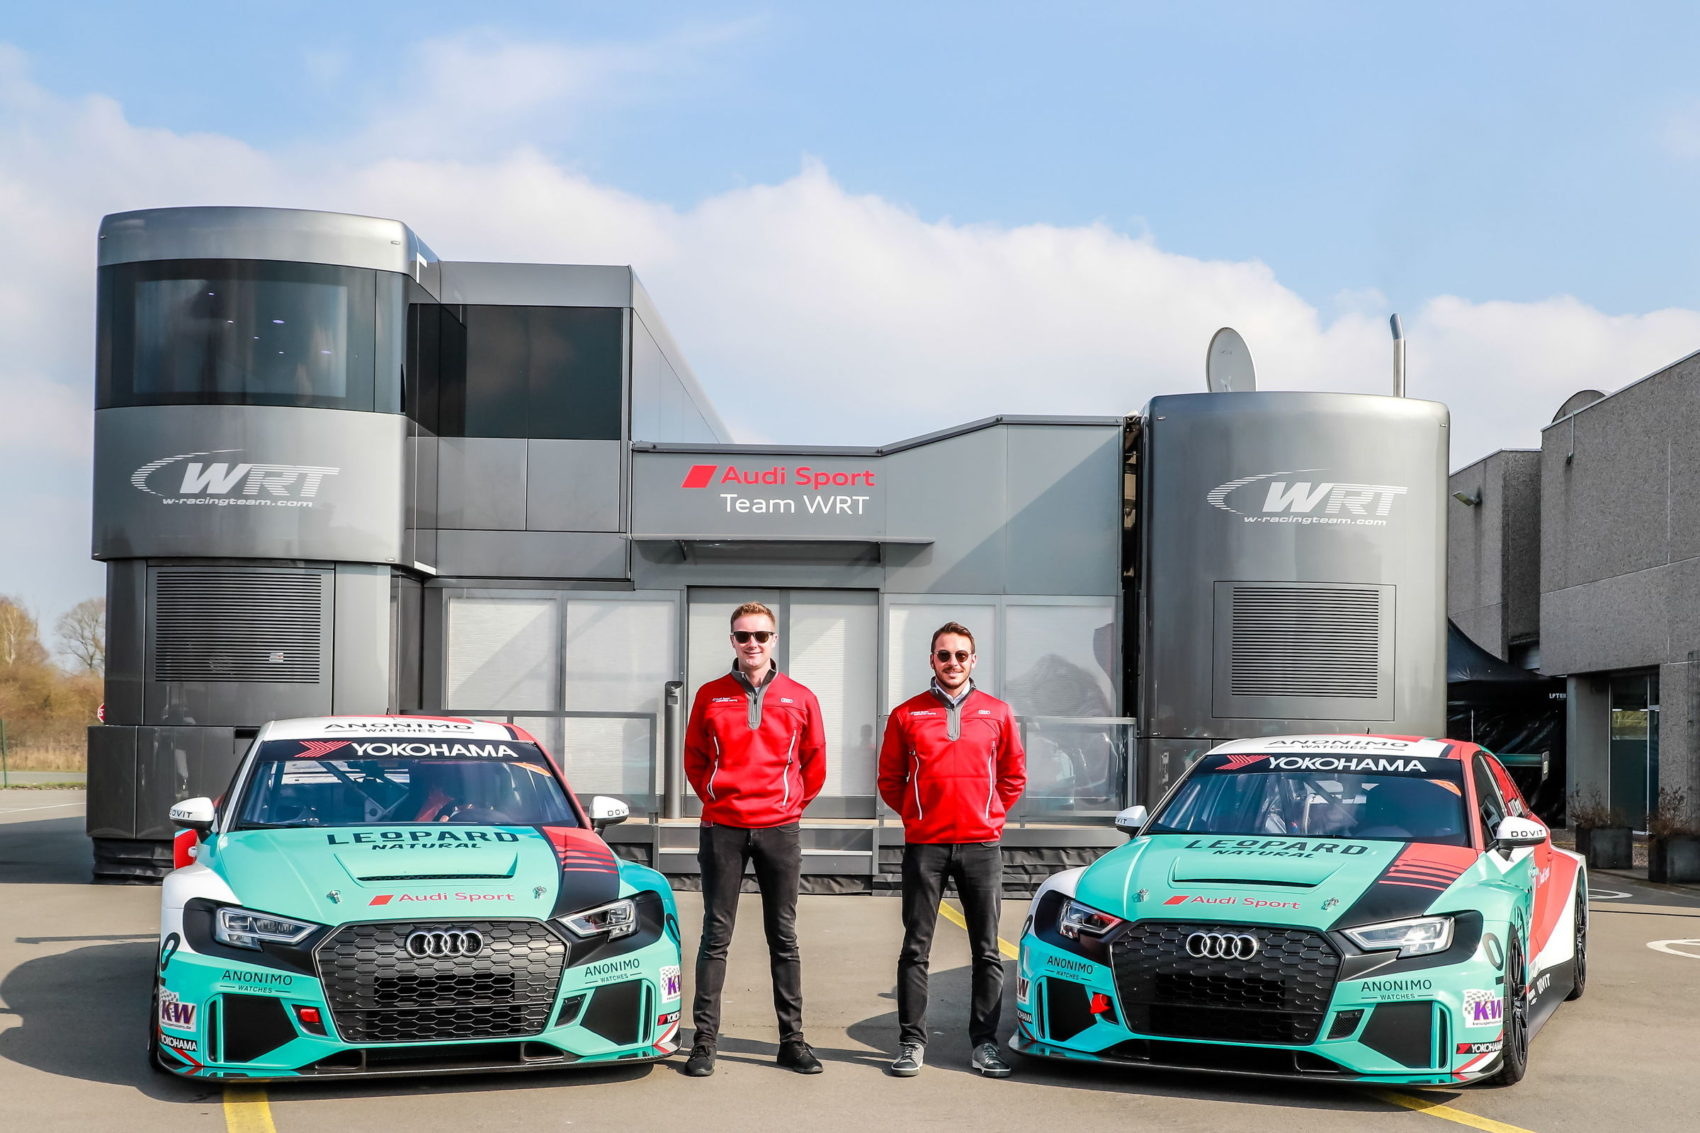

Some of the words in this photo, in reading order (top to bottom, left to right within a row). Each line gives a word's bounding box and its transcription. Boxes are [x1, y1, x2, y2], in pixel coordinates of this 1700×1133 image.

[180, 463, 341, 497] WRT
[720, 466, 786, 485] Audi
[794, 467, 876, 490] Sport
[162, 497, 313, 508] w-racingteam.com
[720, 494, 795, 513] Team
[803, 495, 870, 515] WRT
[1262, 482, 1408, 516] WRT
[1243, 515, 1387, 526] w-racingteam.com
[324, 722, 472, 730] ANONIMO
[351, 743, 520, 758] YOKOHAMA
[1268, 740, 1408, 748] ANONIMO
[1268, 757, 1427, 772] YOKOHAMA
[170, 809, 193, 818] OVIT
[326, 831, 520, 845] LEOPARD
[1510, 829, 1543, 838] DOVIT
[1184, 840, 1369, 855] LEOPARD
[1213, 850, 1315, 858] NATURAL
[399, 893, 448, 902] Audi
[455, 893, 515, 904] Sport
[1190, 896, 1238, 905] Audi
[1242, 897, 1301, 909] Sport
[584, 958, 640, 977] ANONIMO
[1046, 955, 1094, 975] ANONIMO
[222, 969, 293, 986] ANONIMO
[600, 973, 629, 983] WATCHES
[1055, 970, 1080, 981] WATCHES
[238, 985, 273, 993] WATCHES
[1361, 979, 1432, 993] ANONIMO
[161, 1000, 196, 1025] KW
